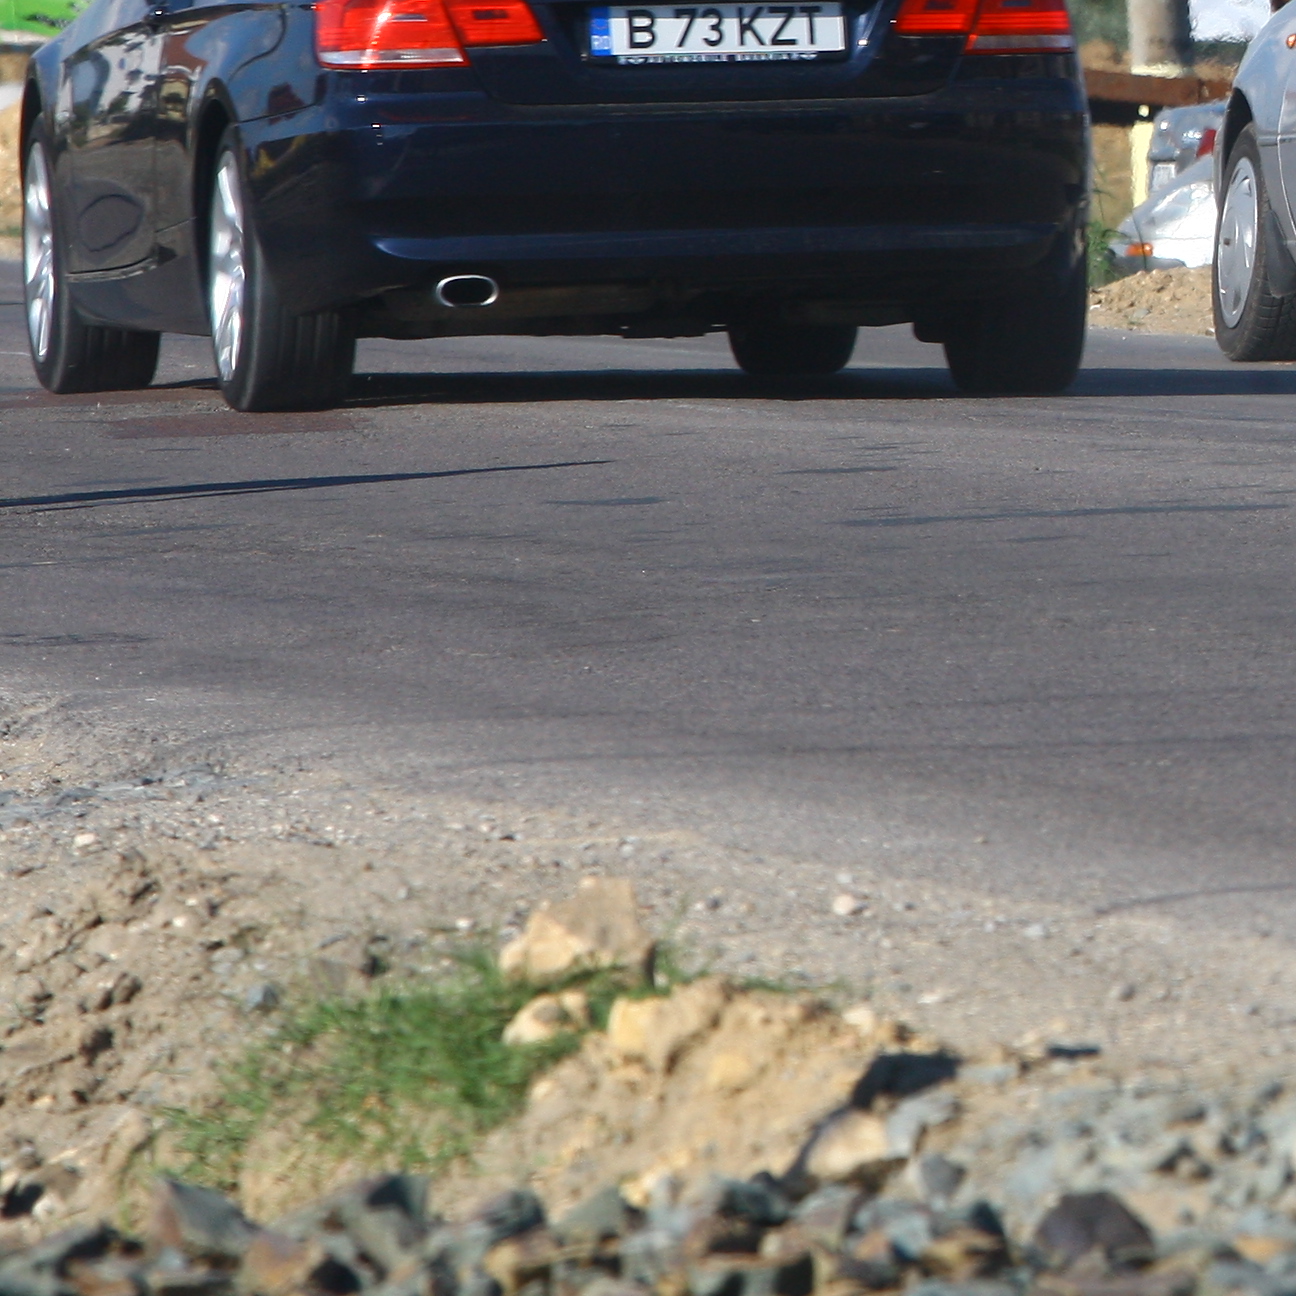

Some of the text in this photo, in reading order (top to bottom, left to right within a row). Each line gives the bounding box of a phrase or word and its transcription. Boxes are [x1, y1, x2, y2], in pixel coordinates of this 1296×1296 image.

[627, 6, 822, 49] B 73 KZT
